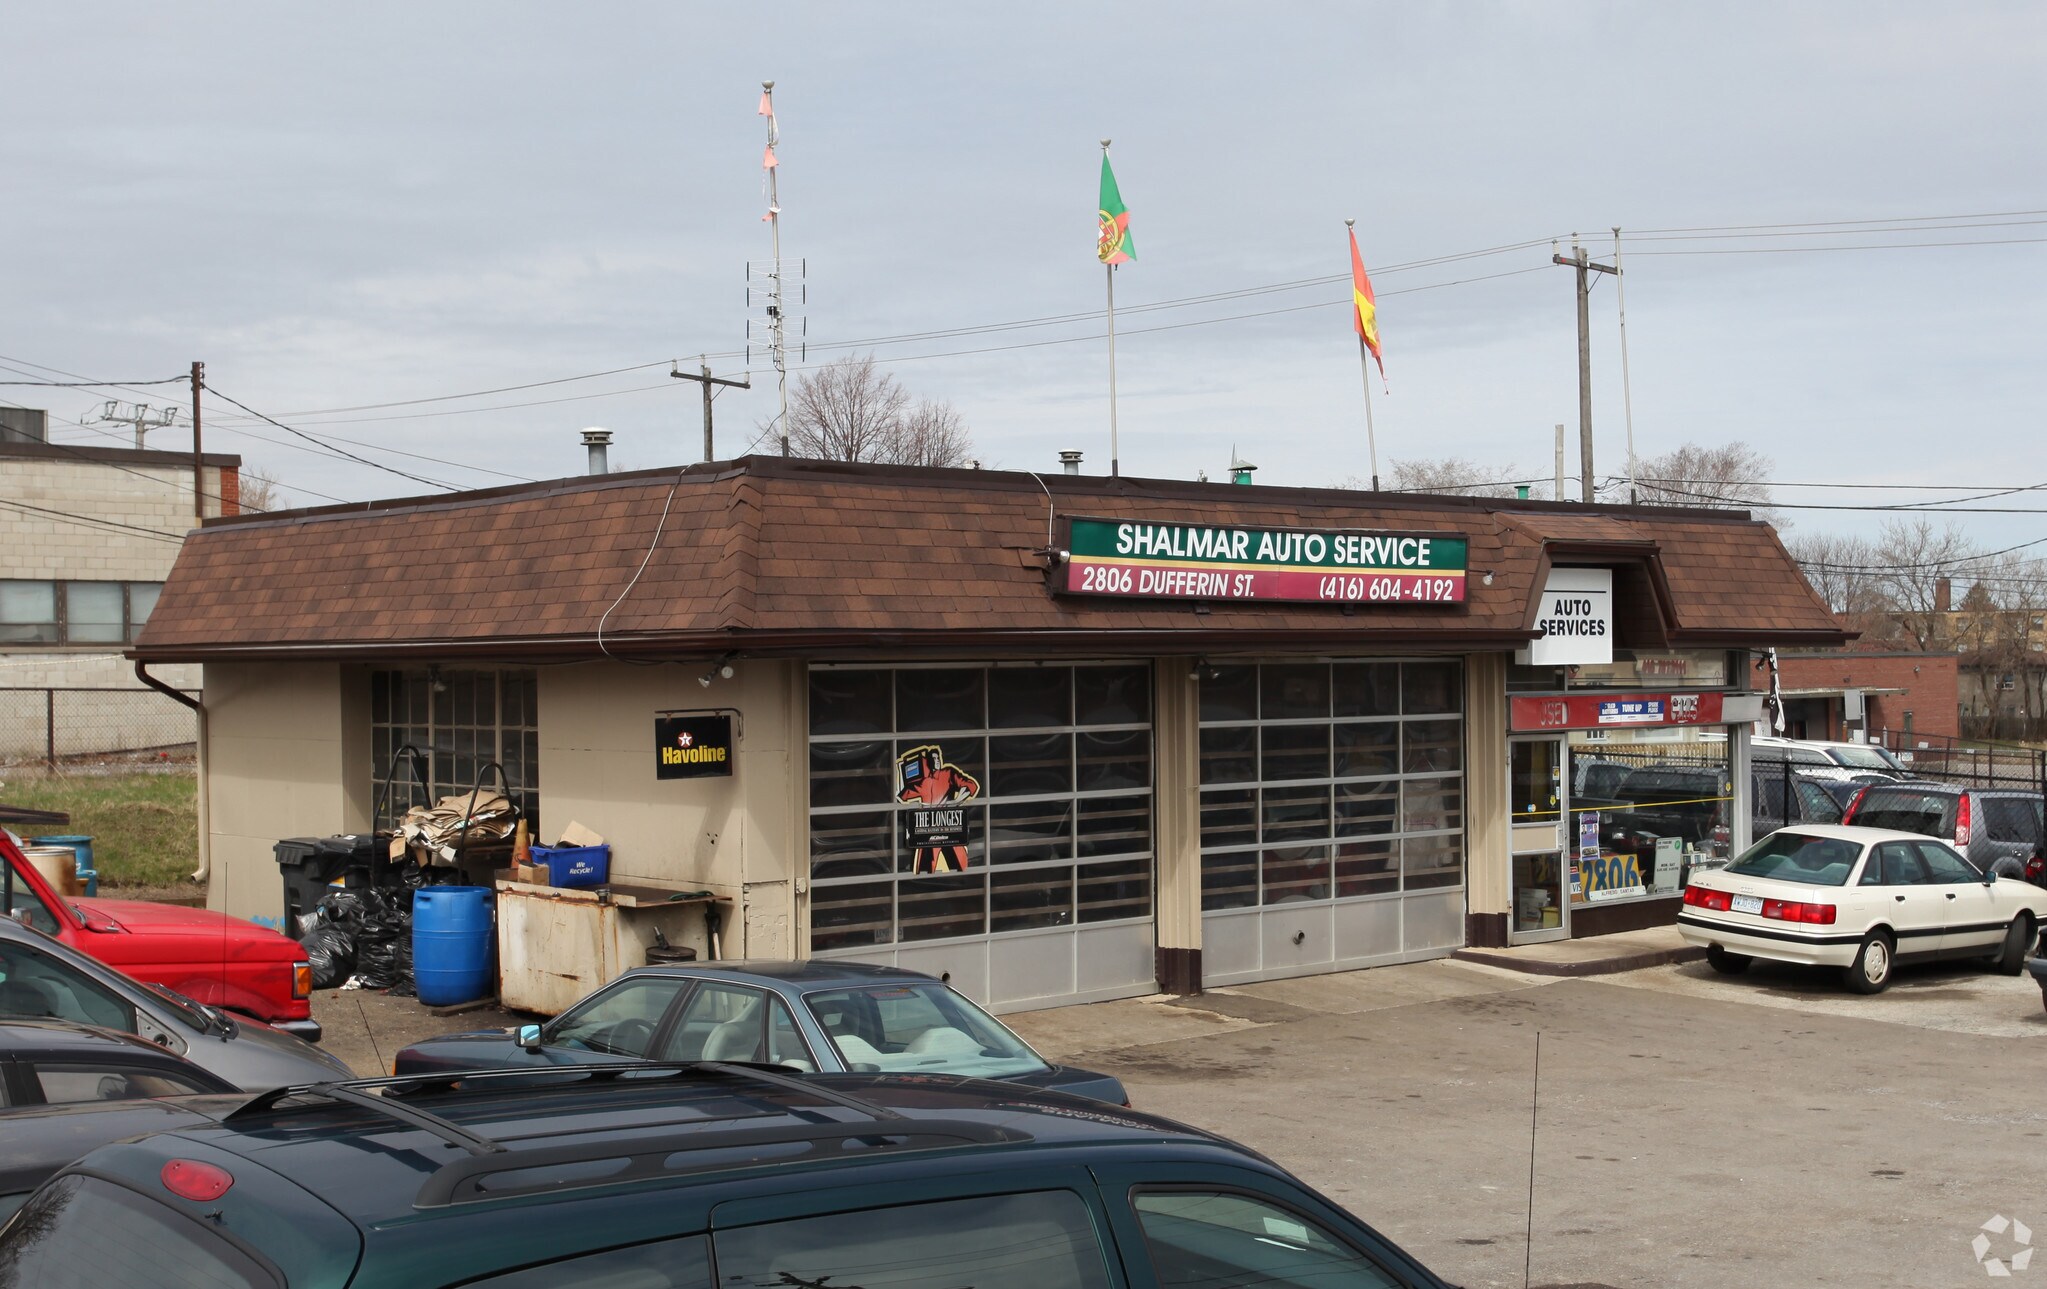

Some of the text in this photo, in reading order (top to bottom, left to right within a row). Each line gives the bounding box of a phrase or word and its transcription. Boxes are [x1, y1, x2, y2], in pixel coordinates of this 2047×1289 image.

[1116, 523, 1431, 566] SHALMAR AUTO SERVICE
[1081, 566, 1133, 593] 2806
[1138, 569, 1229, 597] DUFFERIN
[1232, 574, 1255, 597] ST.
[1319, 576, 1364, 600] (416)
[1554, 599, 1591, 616] AUTO
[1540, 619, 1605, 636] SERVICES
[662, 745, 726, 765] Havoline
[915, 810, 963, 828] THE LONGEST
